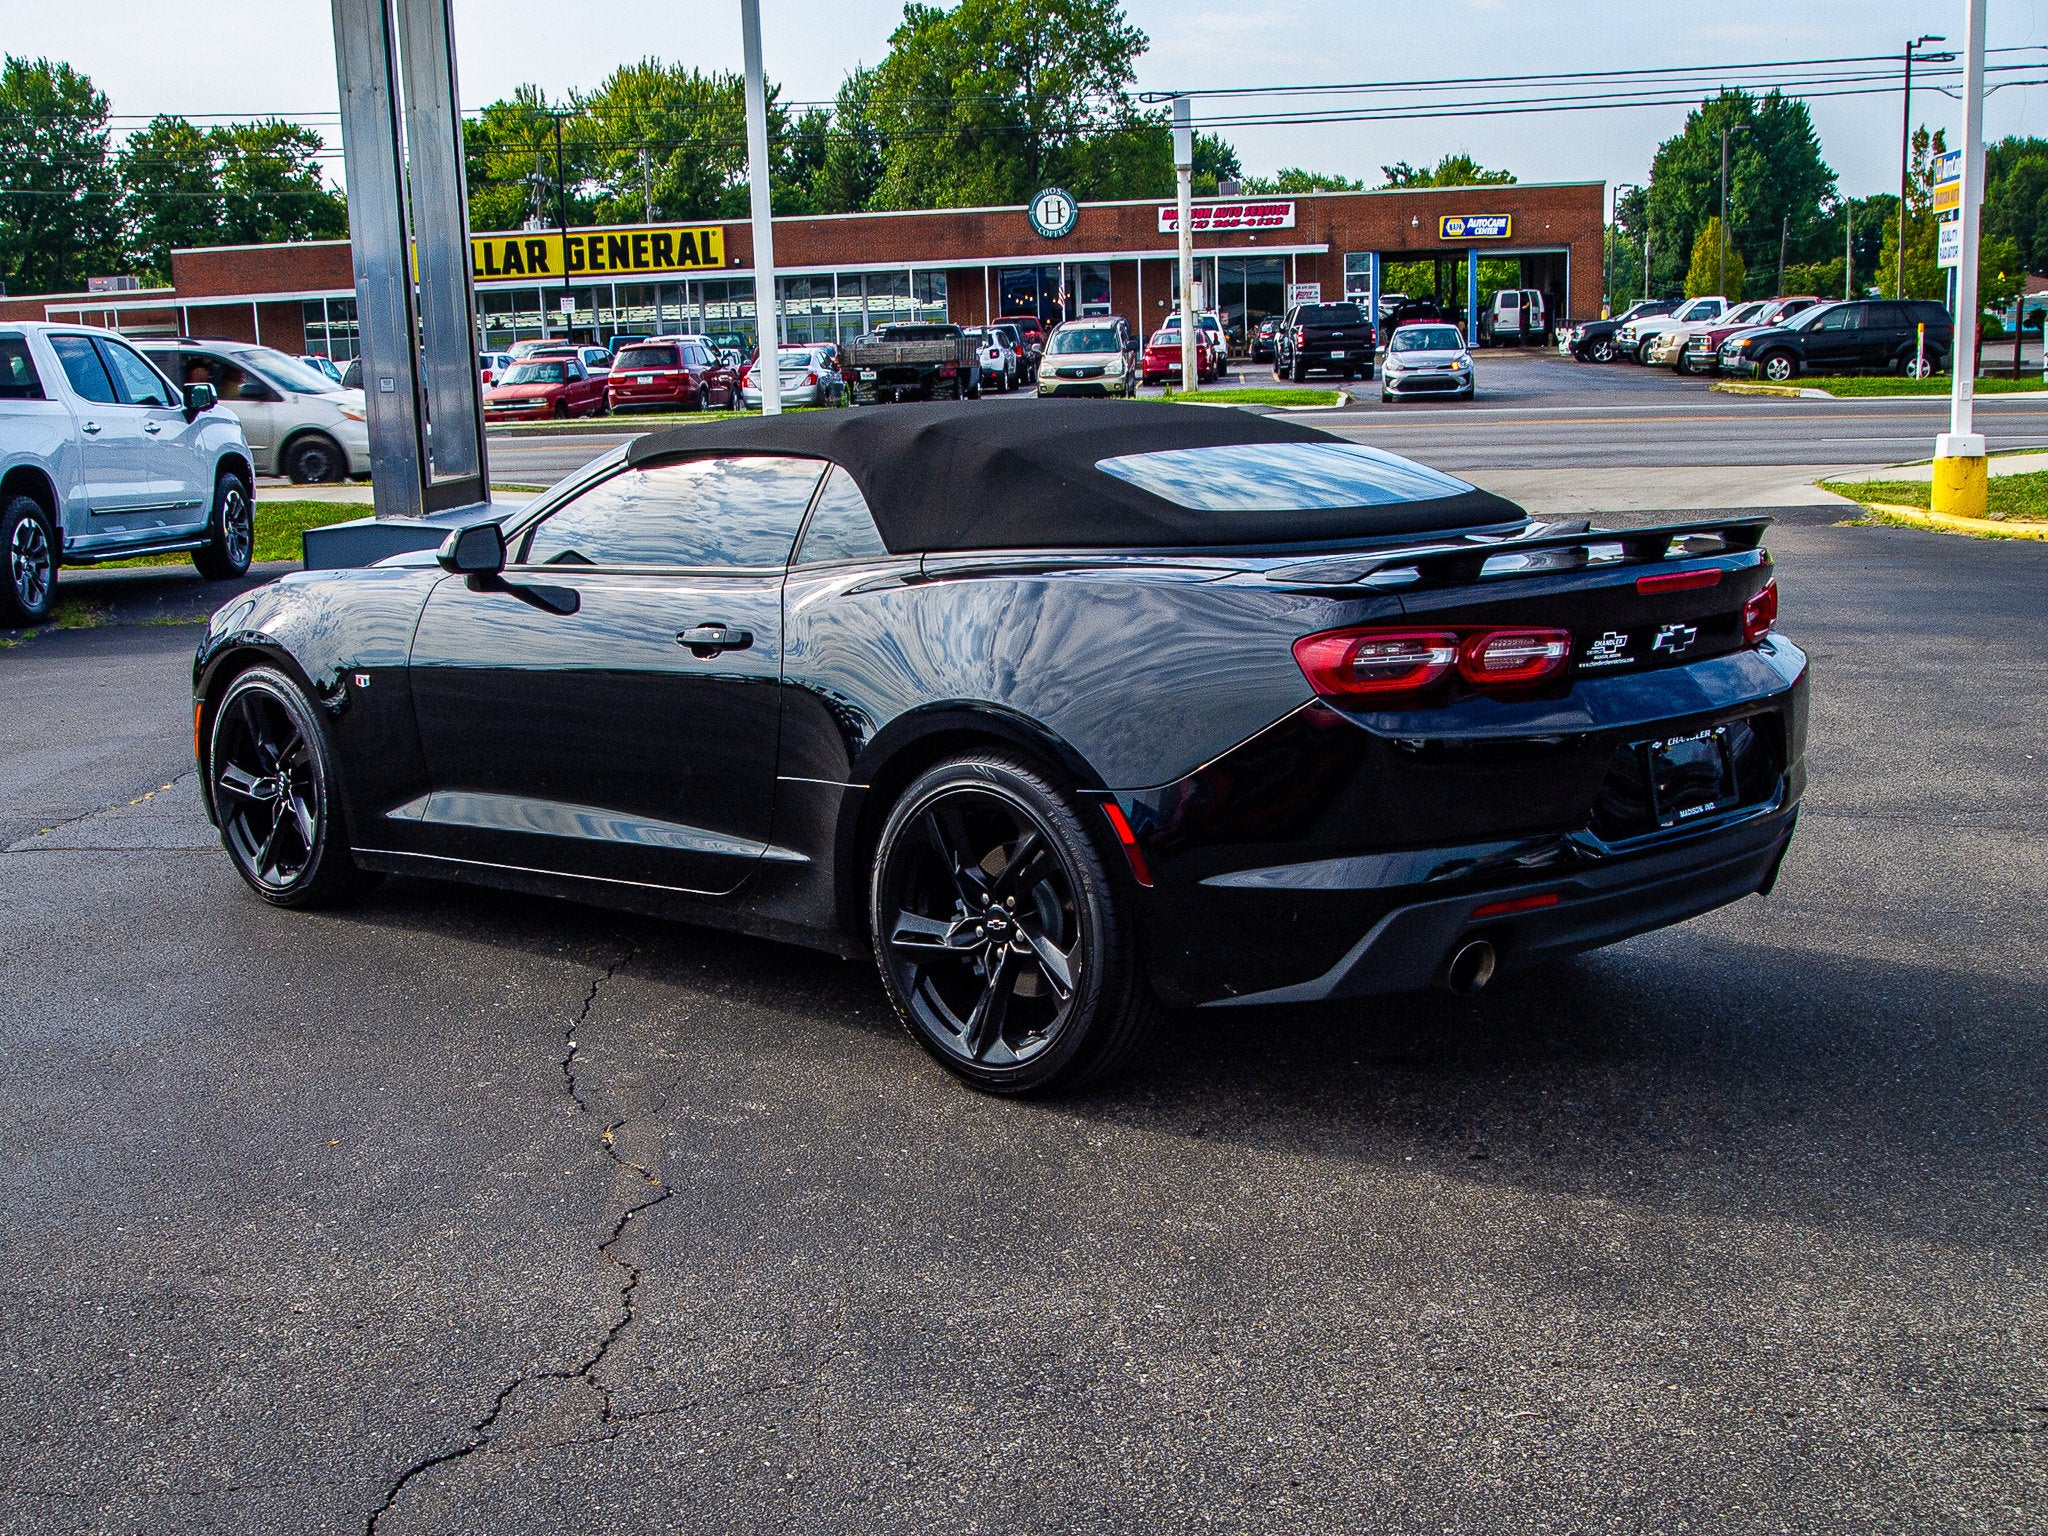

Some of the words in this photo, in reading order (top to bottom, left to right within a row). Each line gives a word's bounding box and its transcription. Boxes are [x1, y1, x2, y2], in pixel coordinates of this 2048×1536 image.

[1213, 206, 1243, 219] AUTO
[1244, 204, 1291, 217] SERVICE
[1038, 226, 1069, 238] COFFEE
[1474, 227, 1499, 235] CENTER
[471, 239, 551, 276] LLAR
[567, 231, 720, 271] GENERAL
[1594, 638, 1624, 648] CHANDLER
[1667, 729, 1712, 746] CHALER
